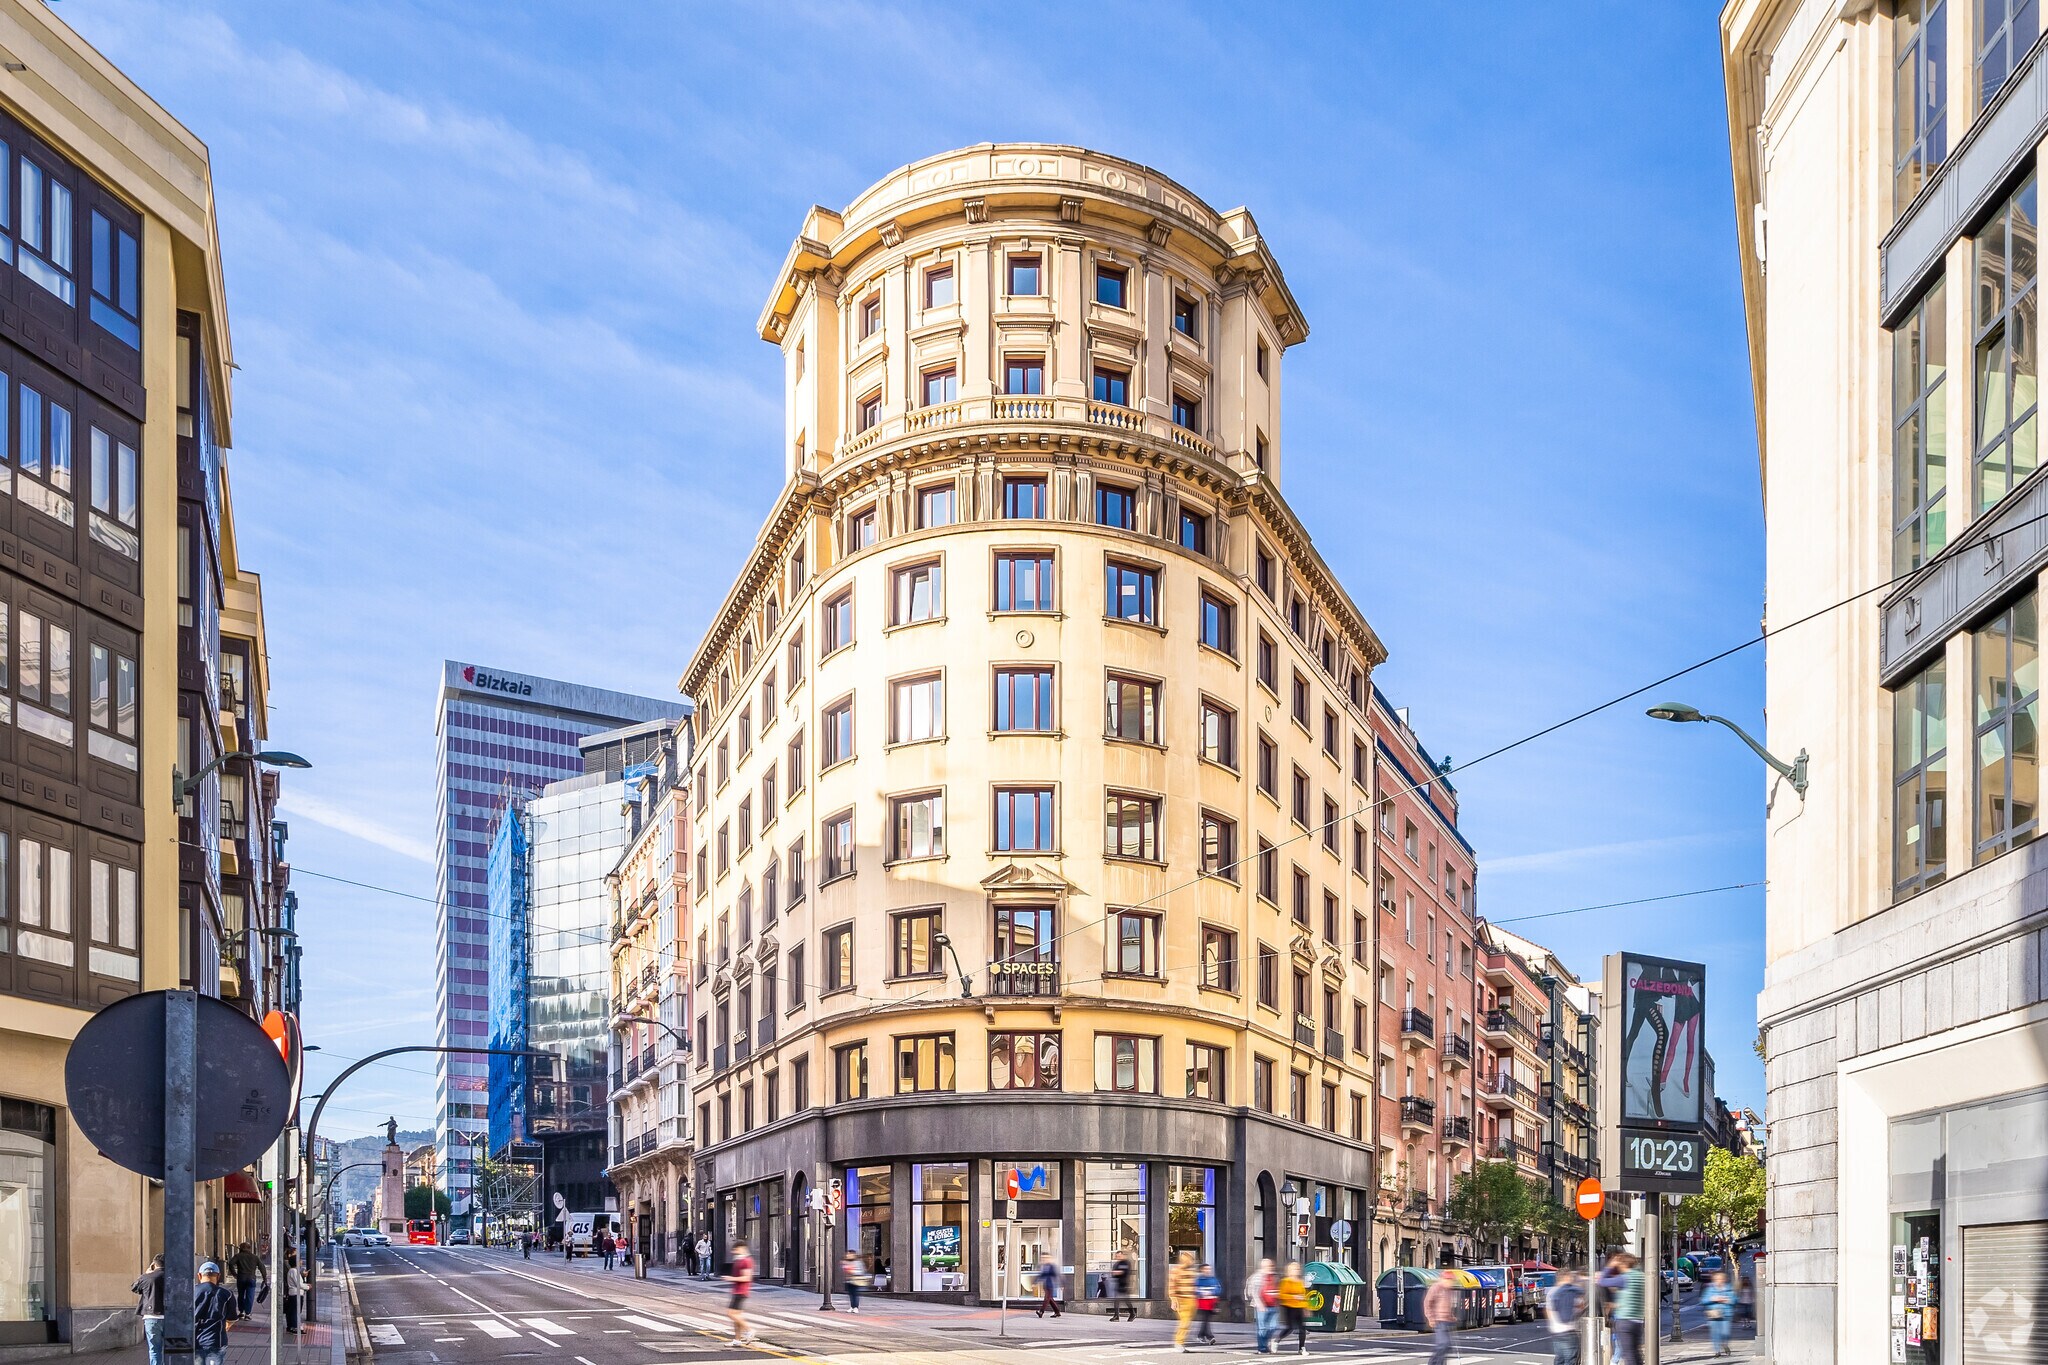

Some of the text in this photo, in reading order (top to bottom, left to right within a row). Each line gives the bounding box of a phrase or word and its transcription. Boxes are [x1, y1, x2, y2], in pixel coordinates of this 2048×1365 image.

[476, 673, 532, 696] Bizkaia
[1629, 978, 1694, 998] CALZEDONIA
[1630, 1137, 1693, 1172] 10:23
[573, 1222, 590, 1234] GLS
